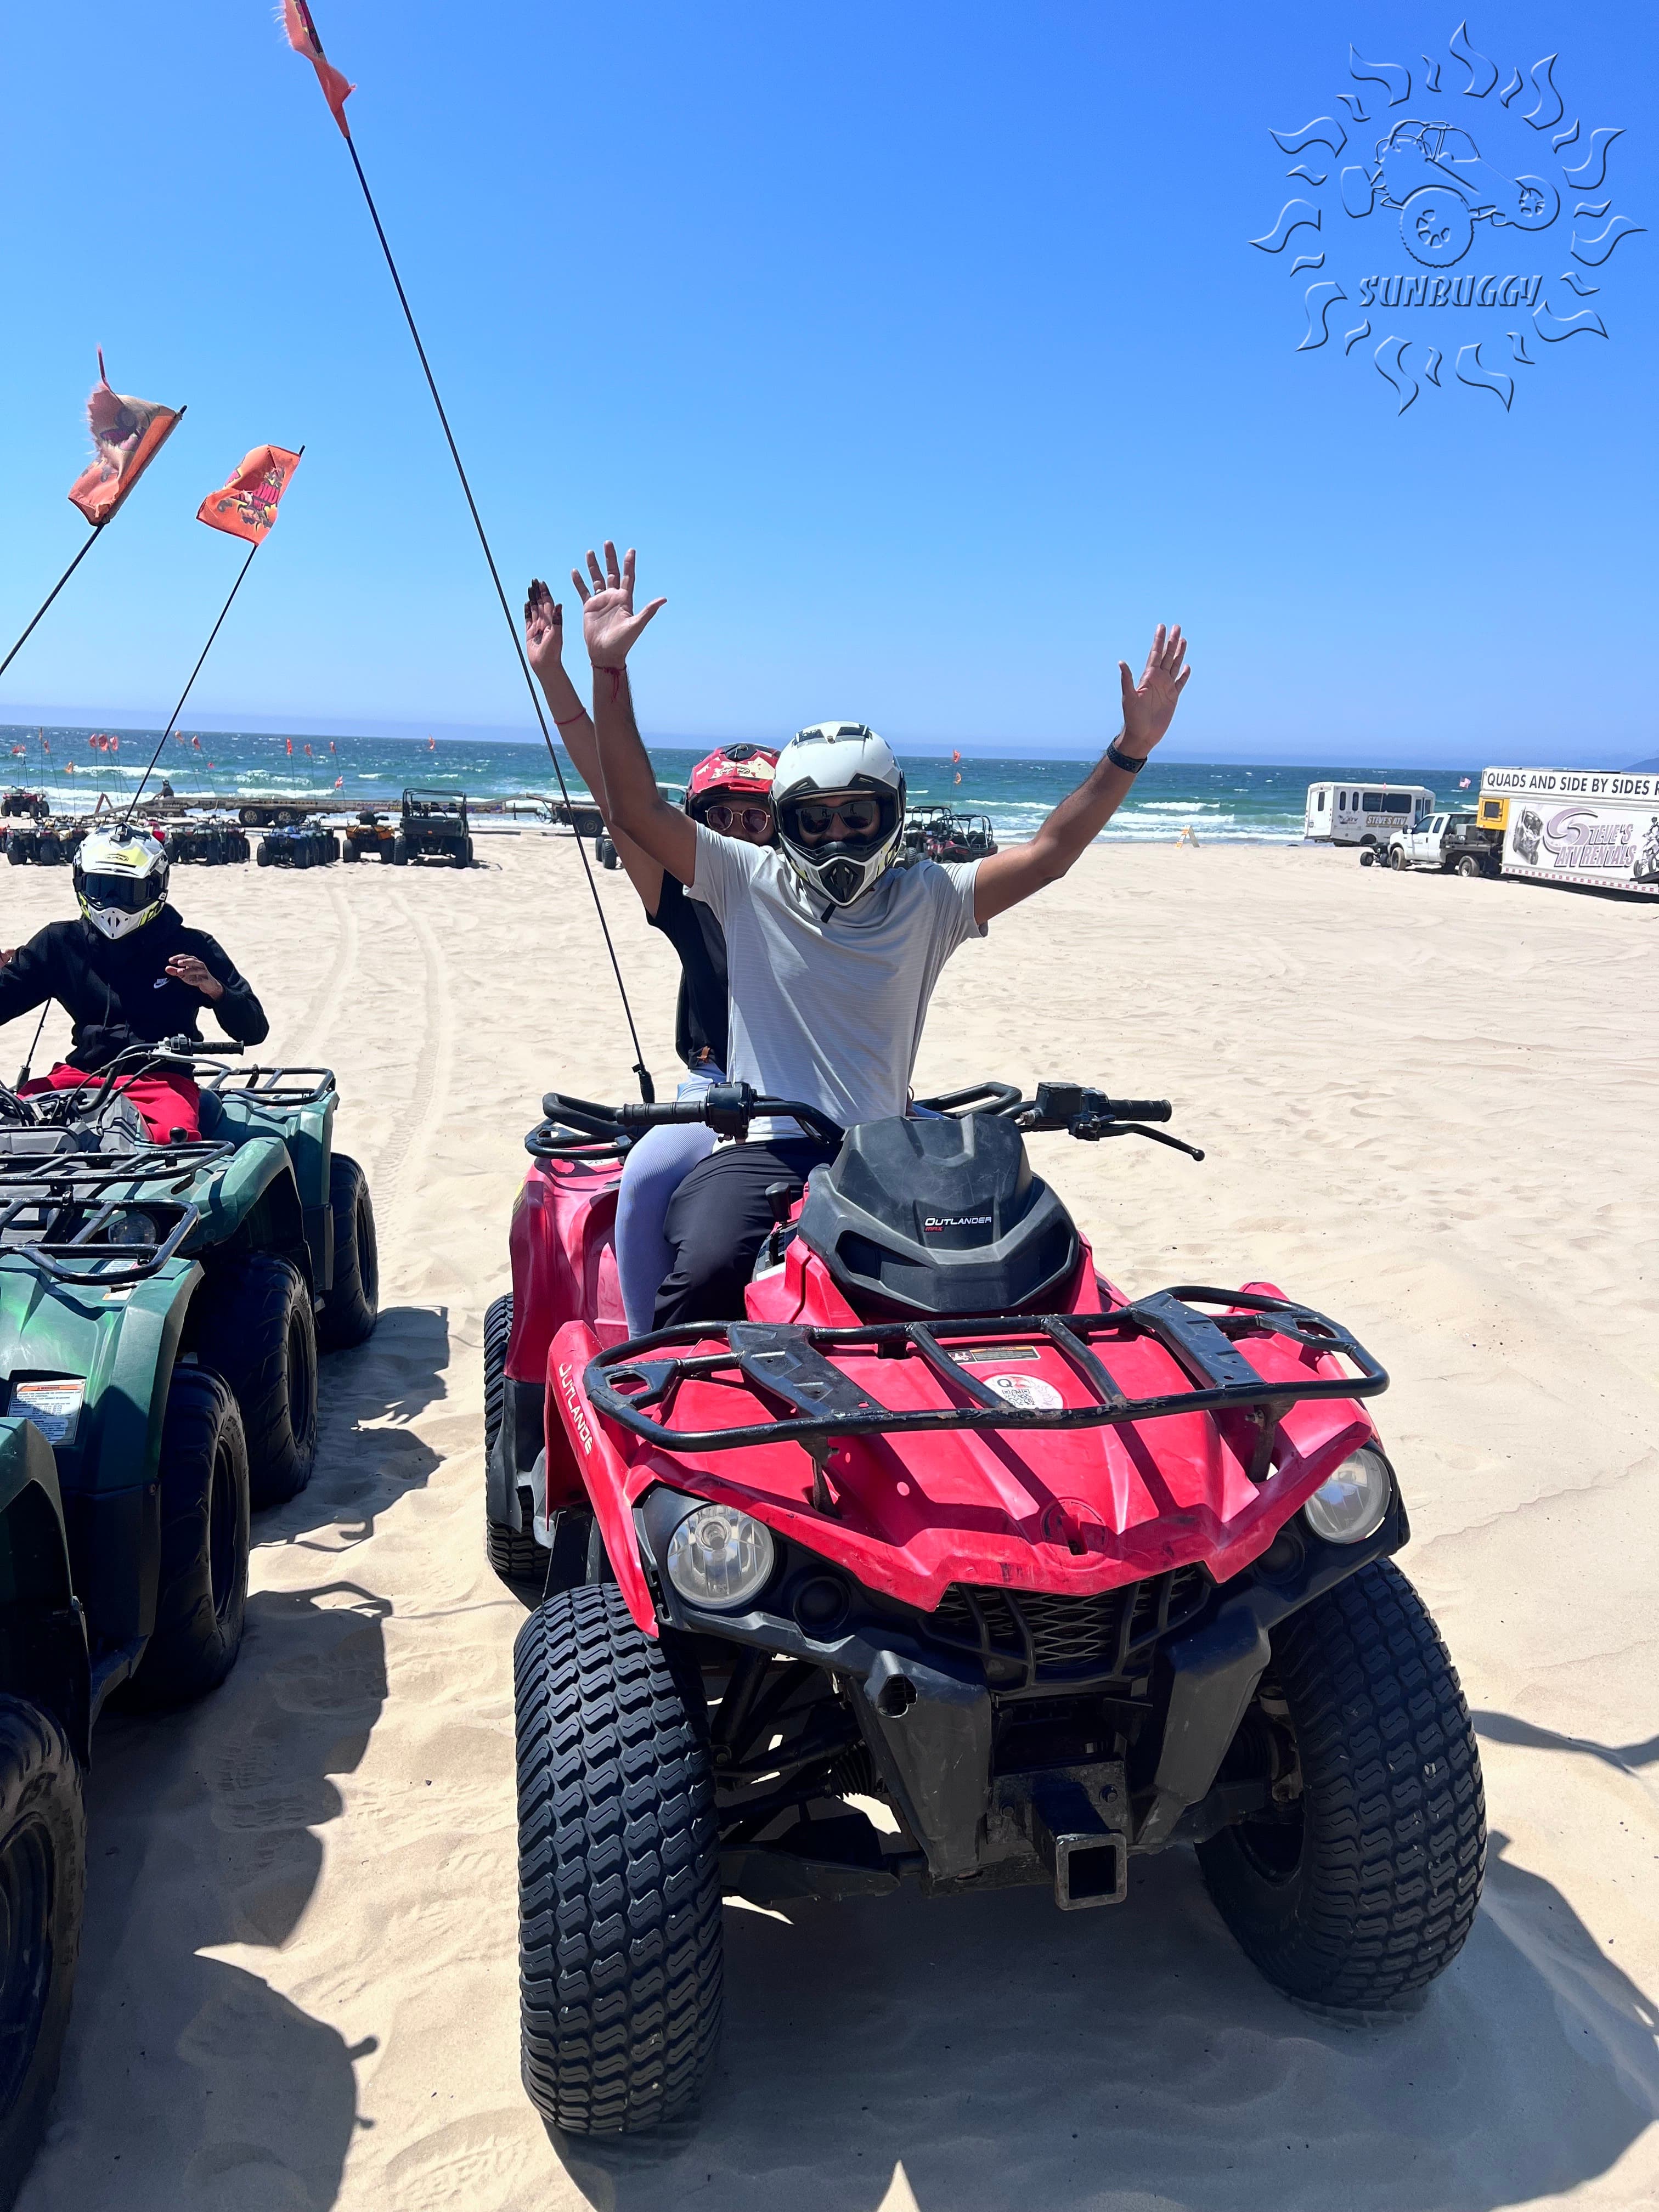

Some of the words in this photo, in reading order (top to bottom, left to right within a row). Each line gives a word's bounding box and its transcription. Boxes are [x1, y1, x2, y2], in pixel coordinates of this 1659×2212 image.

[1487, 772, 1526, 788] QUADS
[1530, 775, 1556, 789] AND
[1560, 776, 1588, 792] SIDE
[1592, 778, 1609, 793] BY
[1611, 778, 1650, 795] SIDES
[1367, 815, 1392, 825] STEVE'S
[1392, 816, 1406, 826] ATV
[1545, 807, 1634, 847] STEVE'S
[1554, 846, 1582, 868] ATV
[1579, 845, 1637, 868] RENTALS
[925, 1216, 992, 1226] OUTLANDER
